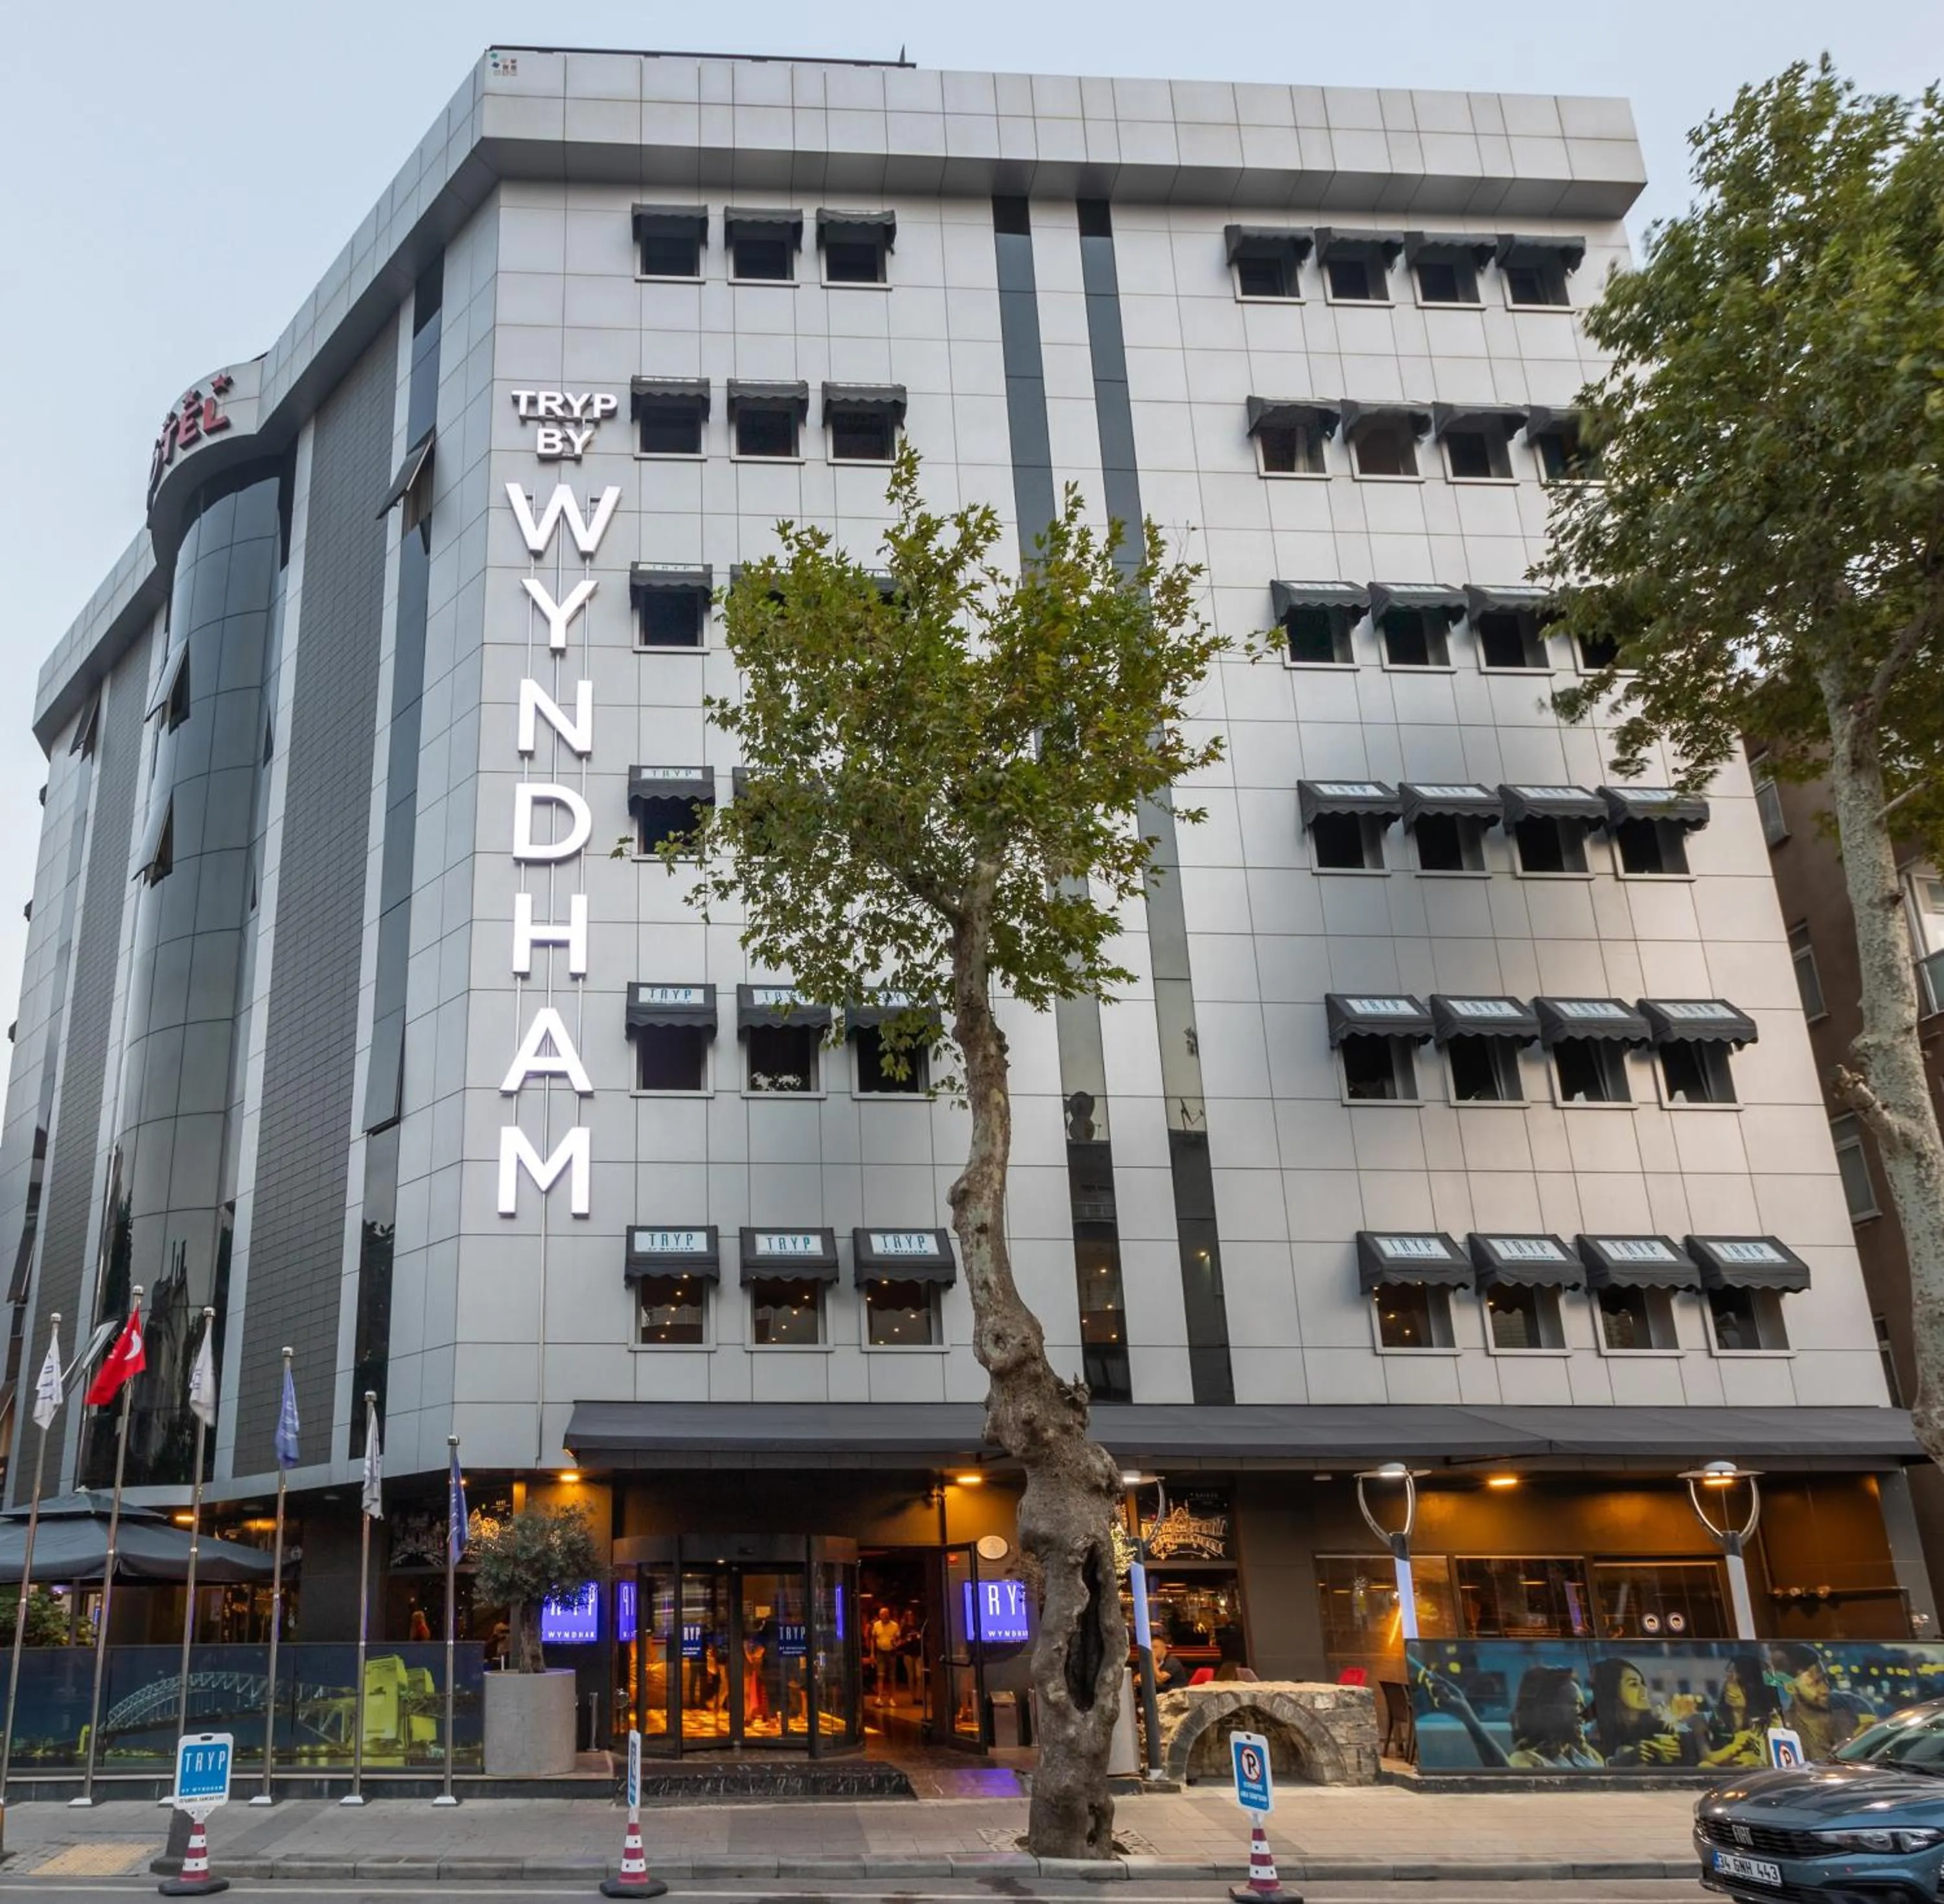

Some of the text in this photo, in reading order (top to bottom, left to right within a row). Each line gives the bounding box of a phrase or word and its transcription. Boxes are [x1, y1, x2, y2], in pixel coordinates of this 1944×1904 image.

[511, 390, 618, 419] TRYP
[537, 428, 594, 454] BY
[497, 483, 621, 1218] WYNDHAM
[649, 988, 691, 1000] TRYP
[649, 1233, 693, 1246] TRYP
[767, 1236, 811, 1249] TRYP
[881, 1235, 925, 1248] TRYP
[1387, 1238, 1432, 1252] TRYP
[1499, 1240, 1546, 1254] TRYP
[1611, 1241, 1656, 1255] TRYP
[1720, 1244, 1766, 1258] TRYP
[684, 1627, 701, 1641] RYP
[779, 1626, 806, 1641] TRYP
[185, 1750, 226, 1773] TRYP
[1757, 1863, 1779, 1880] 443
